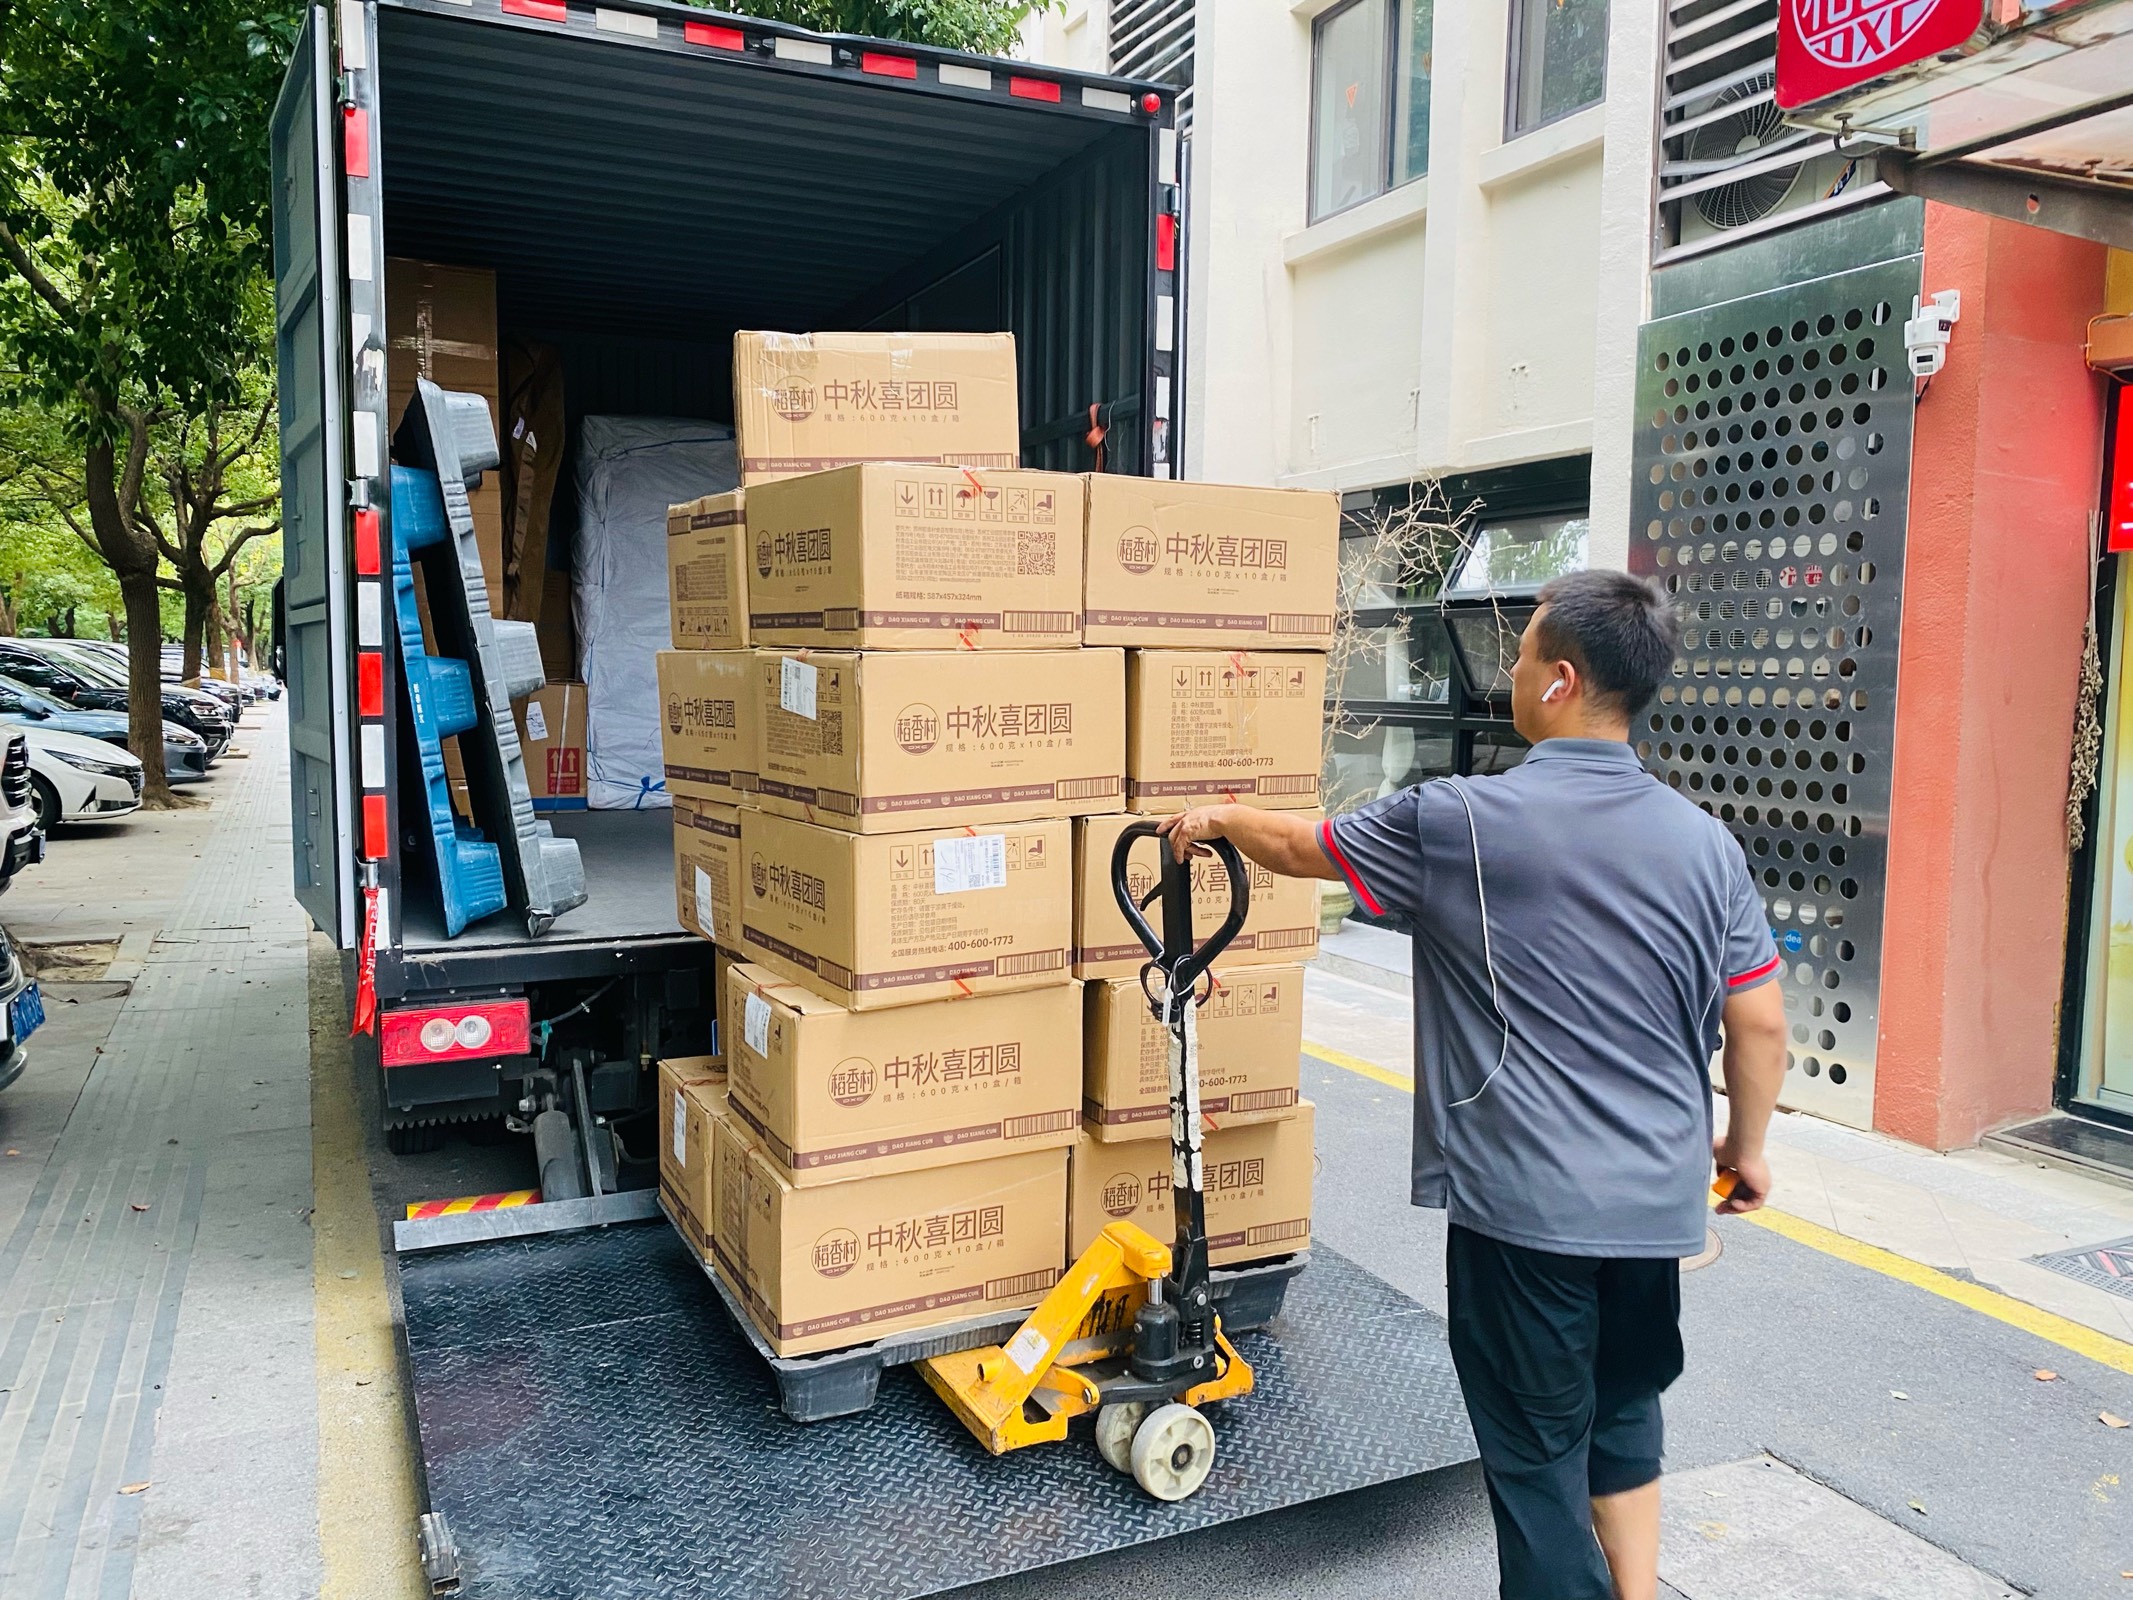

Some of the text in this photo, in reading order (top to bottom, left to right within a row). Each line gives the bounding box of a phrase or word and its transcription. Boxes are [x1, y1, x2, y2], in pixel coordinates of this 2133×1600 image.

[774, 386, 814, 411] 稻香村
[823, 378, 958, 411] 中秋喜团圆
[774, 527, 832, 565] 中秋喜团圆
[1119, 536, 1158, 563] 稻香村
[1165, 531, 1288, 570] 中秋喜团圆
[927, 592, 982, 602] 587x457x324mm
[683, 696, 736, 729] 中秋喜团圆
[946, 702, 1072, 740] 中秋喜团圆
[896, 714, 938, 742] 稻香村
[1217, 757, 1273, 768] 400-600-1773
[903, 798, 921, 806] XIANG
[965, 794, 982, 802] XIANG
[1039, 788, 1051, 796] CUN
[769, 861, 826, 912] 中秋喜团圆
[1126, 872, 1153, 898] 香村
[890, 935, 1014, 958] 全国服务热线电话: 400-600-1773
[1785, 933, 1802, 944] dea
[883, 1042, 1021, 1089] 中秋喜团圆
[831, 1068, 874, 1097] 稻香村
[1199, 1075, 1247, 1088] 0-600-1773
[836, 1150, 854, 1158] XIANG
[854, 1148, 867, 1156] CUN
[904, 1140, 921, 1148] XIANG
[957, 1132, 969, 1140] DAO
[969, 1130, 986, 1138] XIANG
[985, 1128, 997, 1136] CUN
[1148, 1158, 1264, 1201] 中喜团圆
[1103, 1183, 1140, 1208] 稻香村
[866, 1205, 1004, 1257] 中秋喜团圆
[813, 1238, 858, 1269] 稻香村
